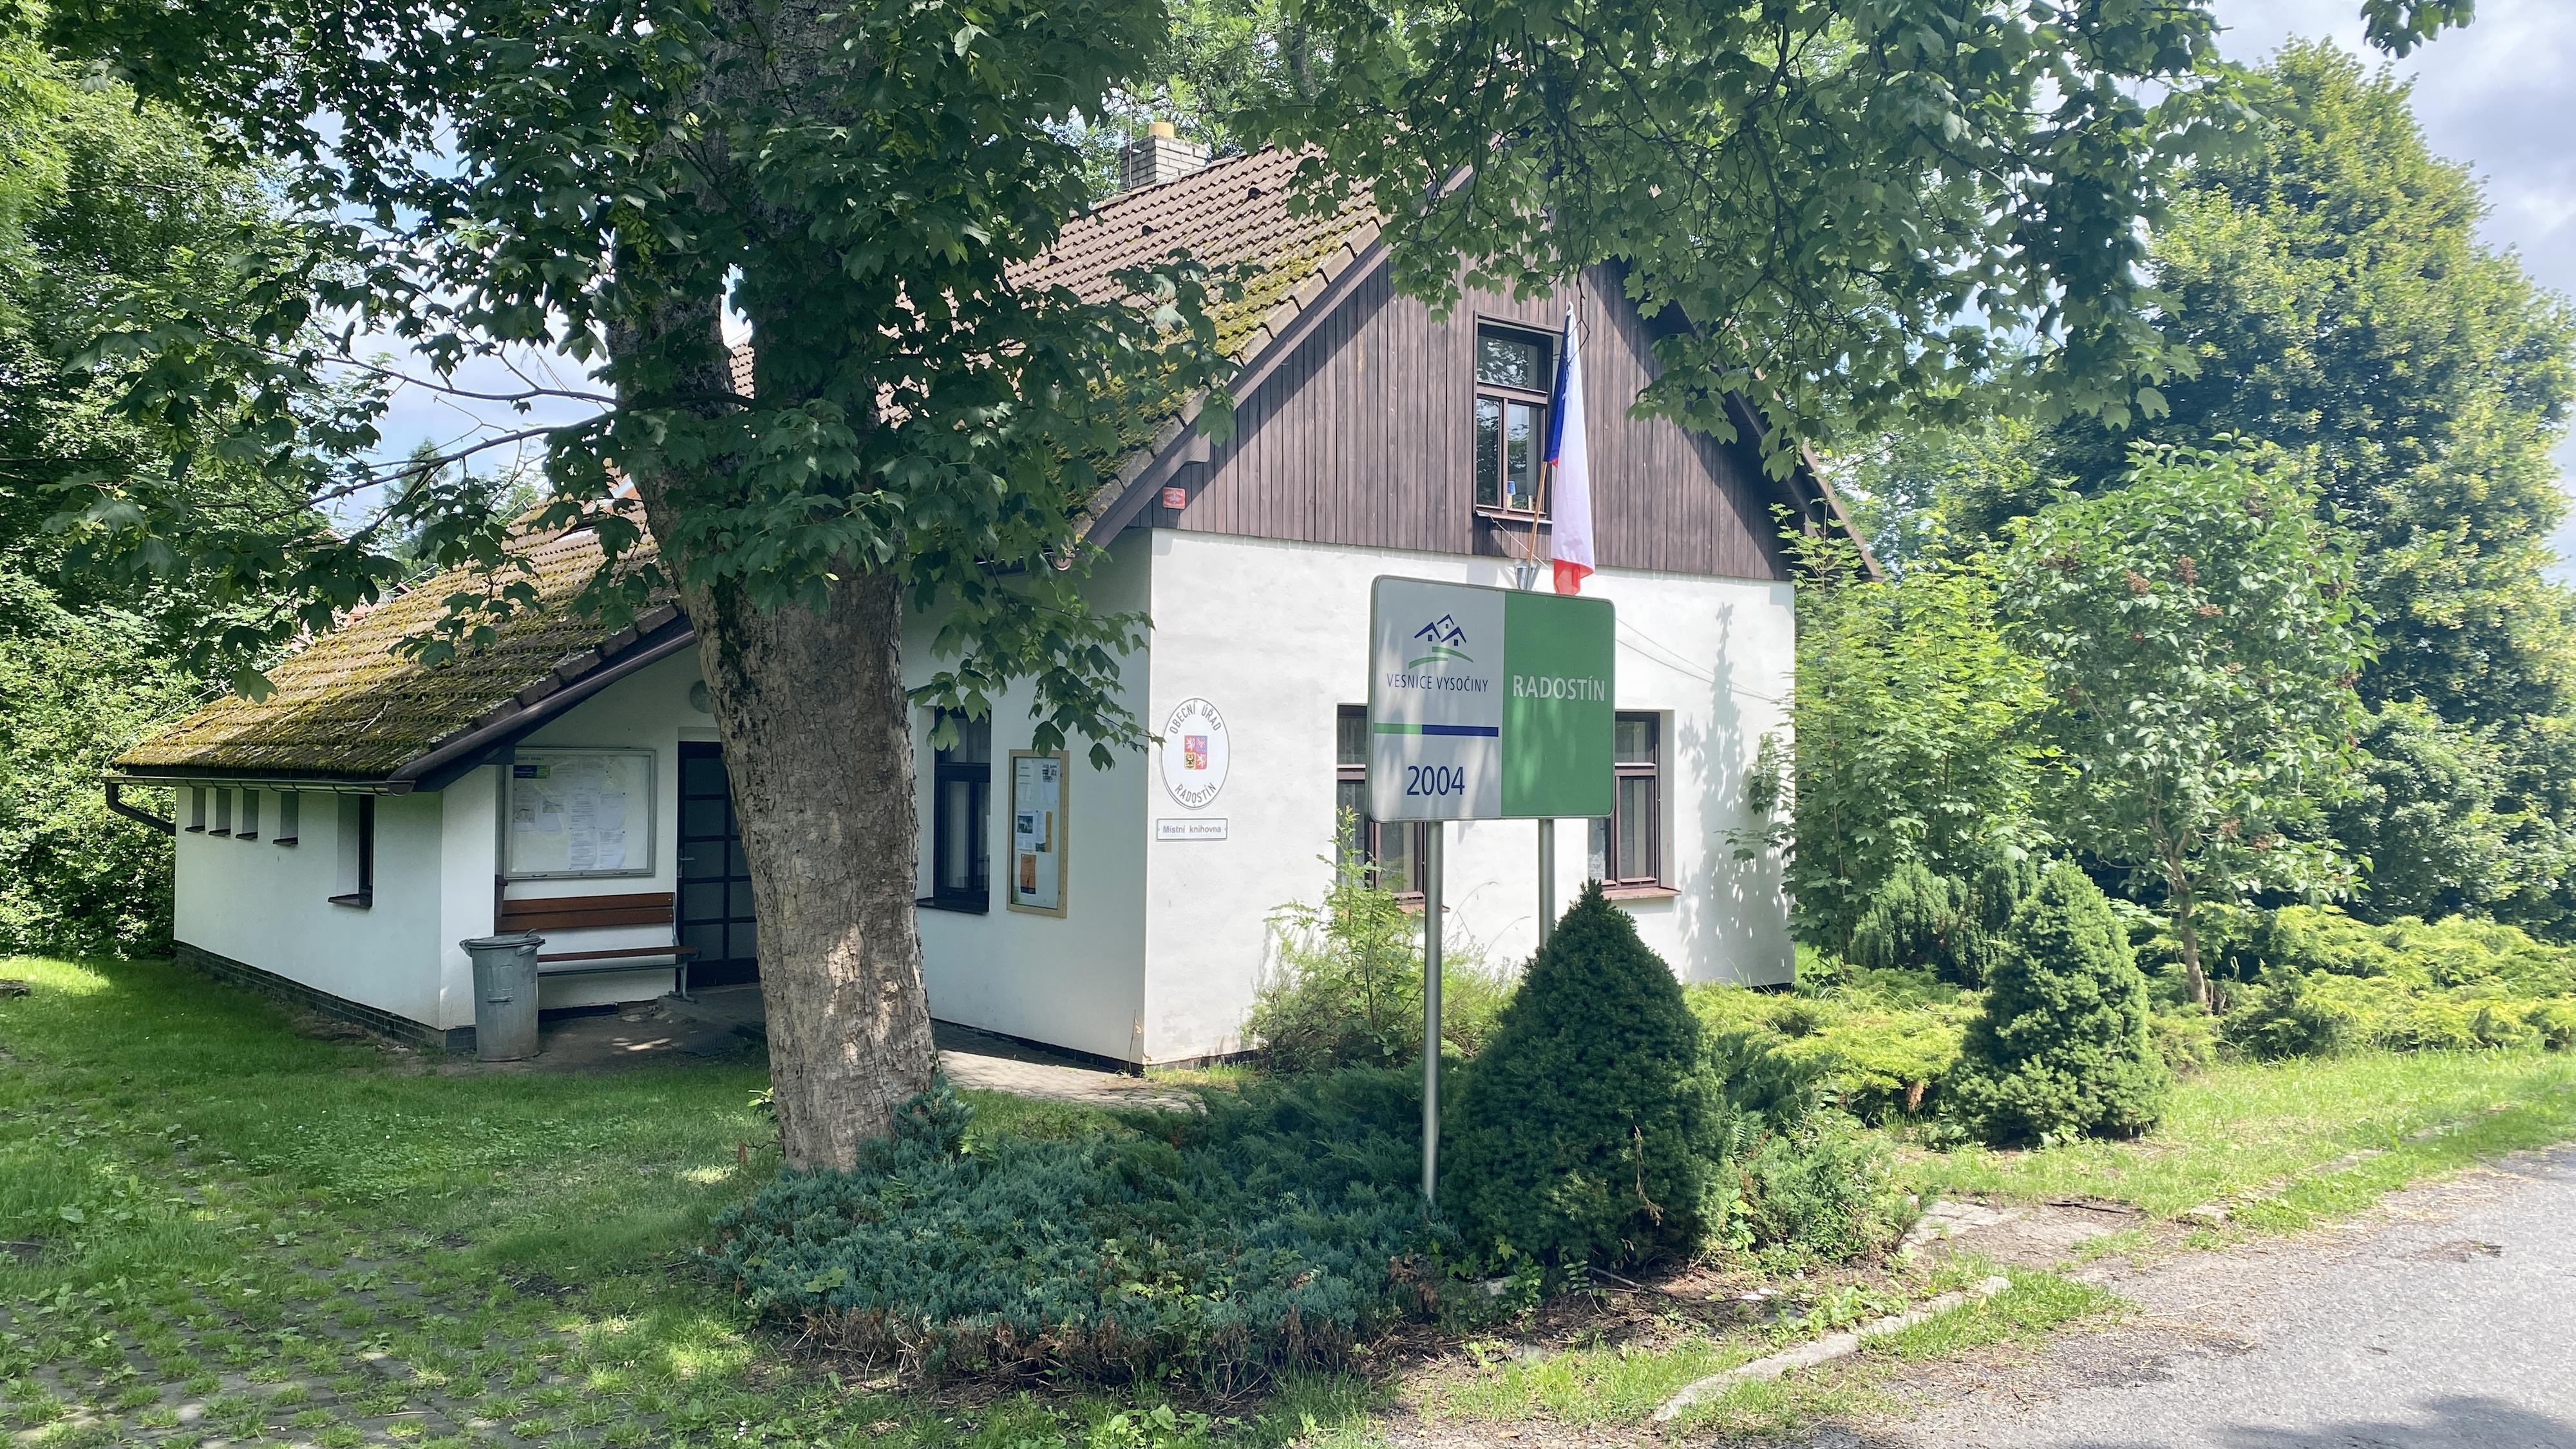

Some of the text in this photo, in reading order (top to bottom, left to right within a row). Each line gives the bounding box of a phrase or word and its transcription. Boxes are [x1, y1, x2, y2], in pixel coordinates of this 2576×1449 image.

[1387, 673, 1489, 692] VESNICE VYSOČINY
[1512, 674, 1605, 701] RADOSTÍN
[1170, 700, 1222, 734] OBECNÍ ÚŘAD
[1175, 782, 1217, 804] RADOSTÍN
[1406, 765, 1466, 797] 2004
[1162, 825, 1222, 833] Místní knihovna
